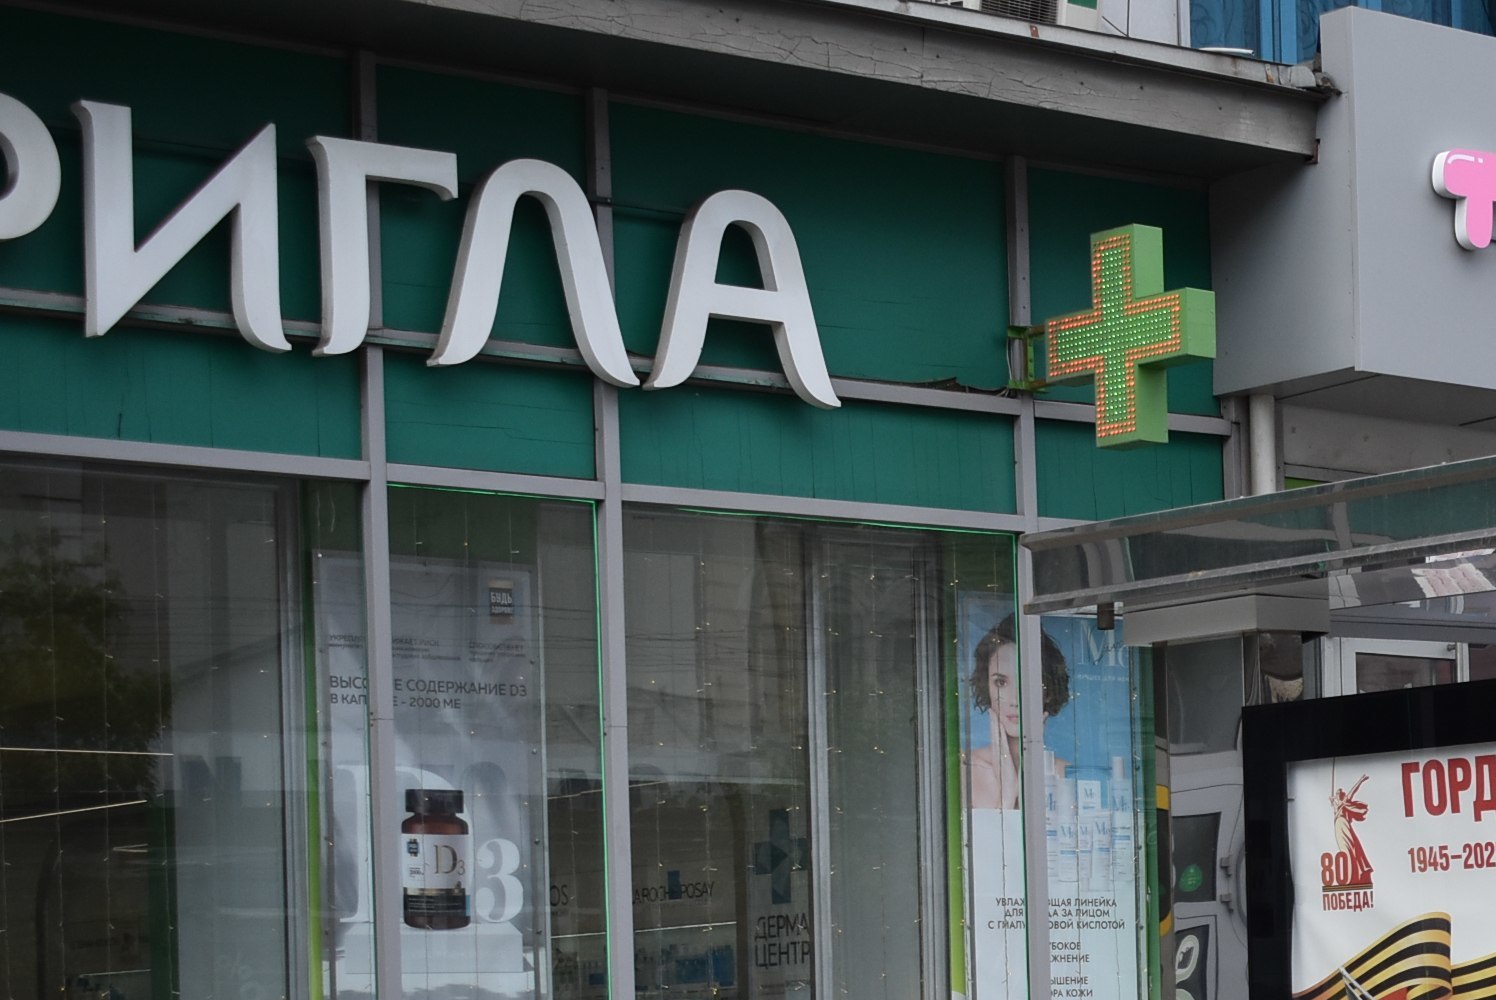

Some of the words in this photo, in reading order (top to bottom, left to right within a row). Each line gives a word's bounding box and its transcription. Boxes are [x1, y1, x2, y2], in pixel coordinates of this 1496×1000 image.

[329, 675, 403, 691] ВЫСЕ
[406, 678, 506, 697] СОДЕРЖАНИЕ
[509, 684, 528, 697] D3
[330, 693, 338, 704] В
[341, 694, 398, 707] КАПЕ
[409, 697, 441, 708] 2000
[443, 698, 461, 709] МЕ
[1320, 851, 1348, 886] 80
[1073, 896, 1117, 907] ЛИНЕЙКА
[1322, 890, 1374, 912] ПОБЕДА!
[1005, 908, 1024, 918] ДЛЯ
[1061, 908, 1073, 917] ЗА
[1075, 908, 1110, 918] ЛИЦОМ
[987, 920, 995, 930] С
[1077, 919, 1125, 930] КИСЛОТОЙ
[1049, 941, 1081, 951] БОКОЕ
[755, 940, 811, 969] ЦЕНТР
[1050, 954, 1090, 963] ЖНЕНИЕ
[1066, 988, 1093, 998] КОЖИ
